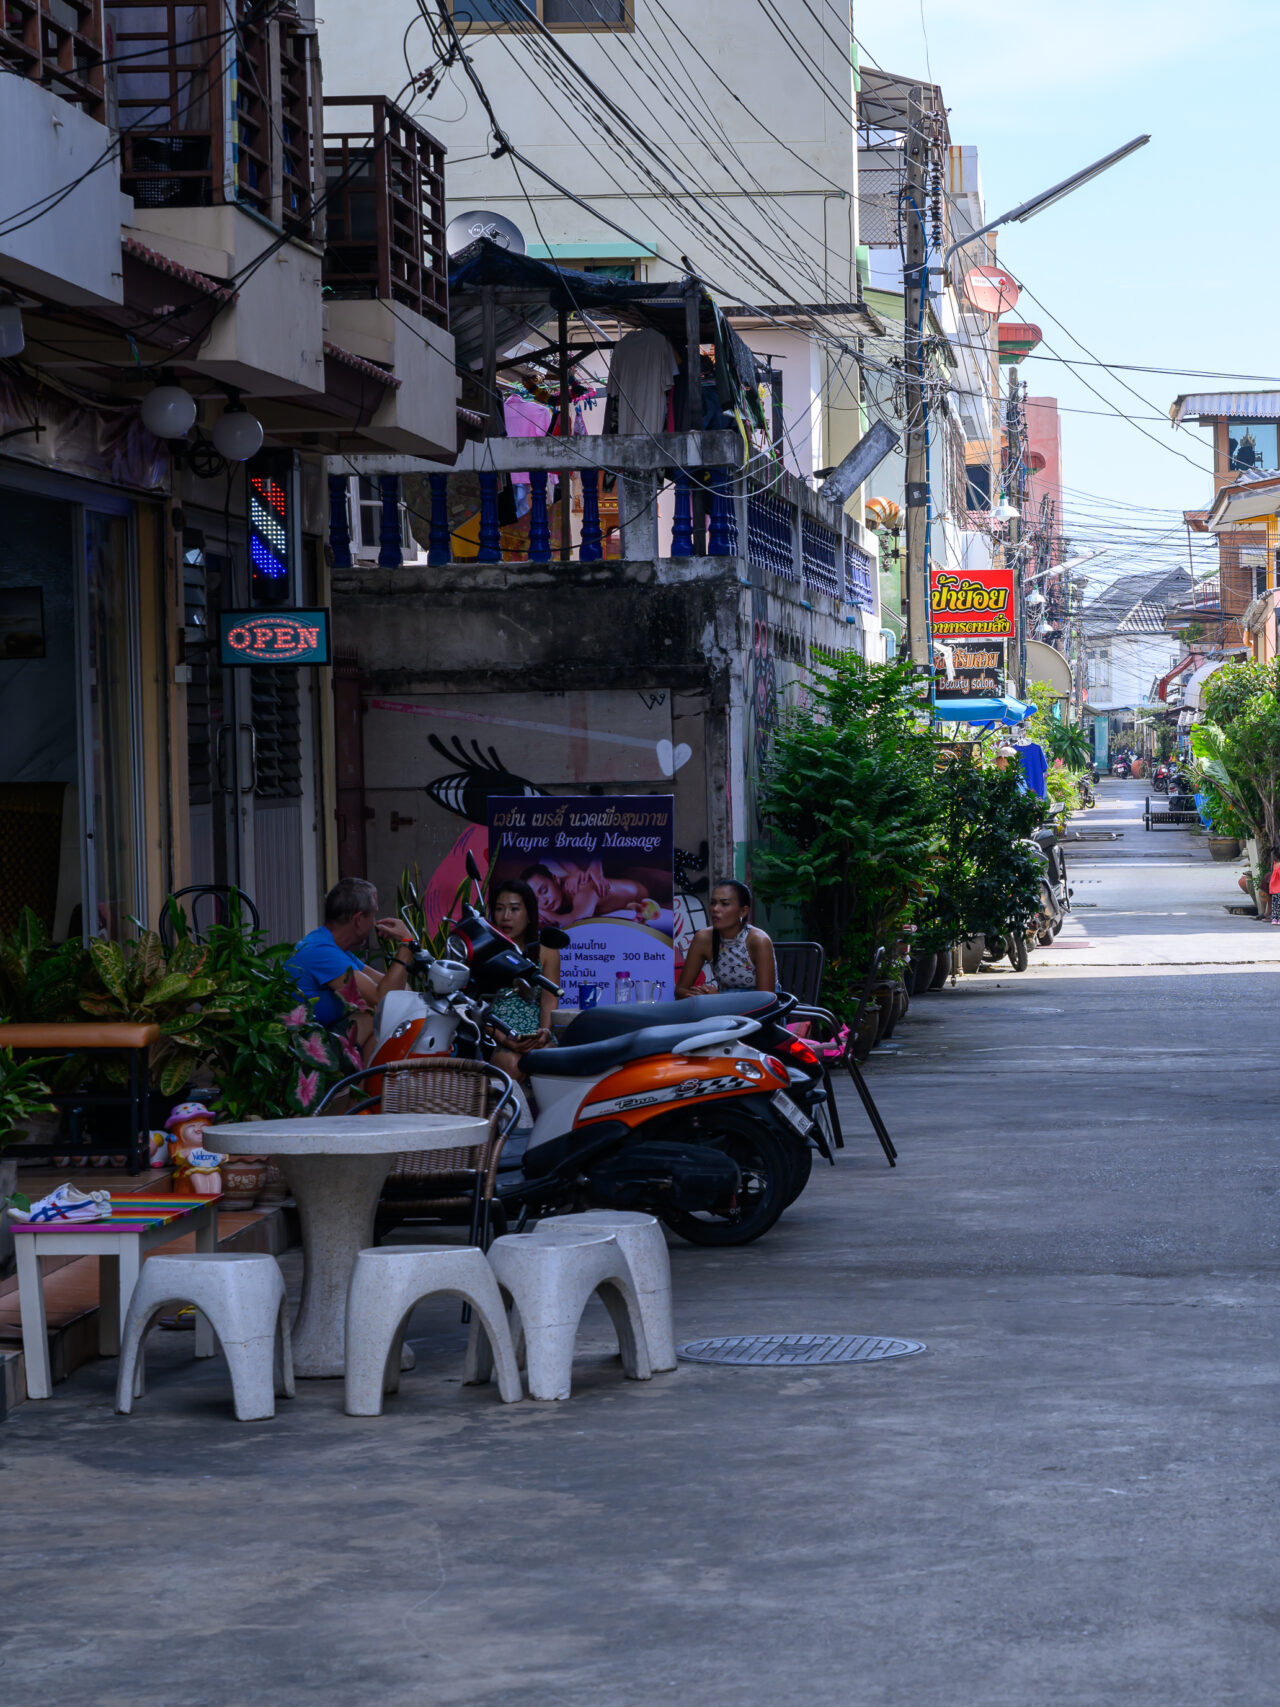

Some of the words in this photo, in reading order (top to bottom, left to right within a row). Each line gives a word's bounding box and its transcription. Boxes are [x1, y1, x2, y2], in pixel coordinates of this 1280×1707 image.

[931, 574, 1009, 612] ป้าย้อย
[930, 614, 1011, 634] อาหารตามสั่ง
[228, 627, 319, 649] OPEN
[939, 676, 970, 694] Beauty
[972, 672, 995, 689] salon
[493, 807, 526, 827] เวย์น
[569, 806, 668, 831] นวดเพื่อสุขภาพ
[502, 831, 549, 852] Wayne
[554, 831, 597, 852] Brady
[601, 832, 661, 852] Massage
[575, 953, 616, 963] Massage
[622, 953, 641, 961] 300
[644, 952, 666, 961] Baht
[560, 965, 596, 977] วดน้ำมัน
